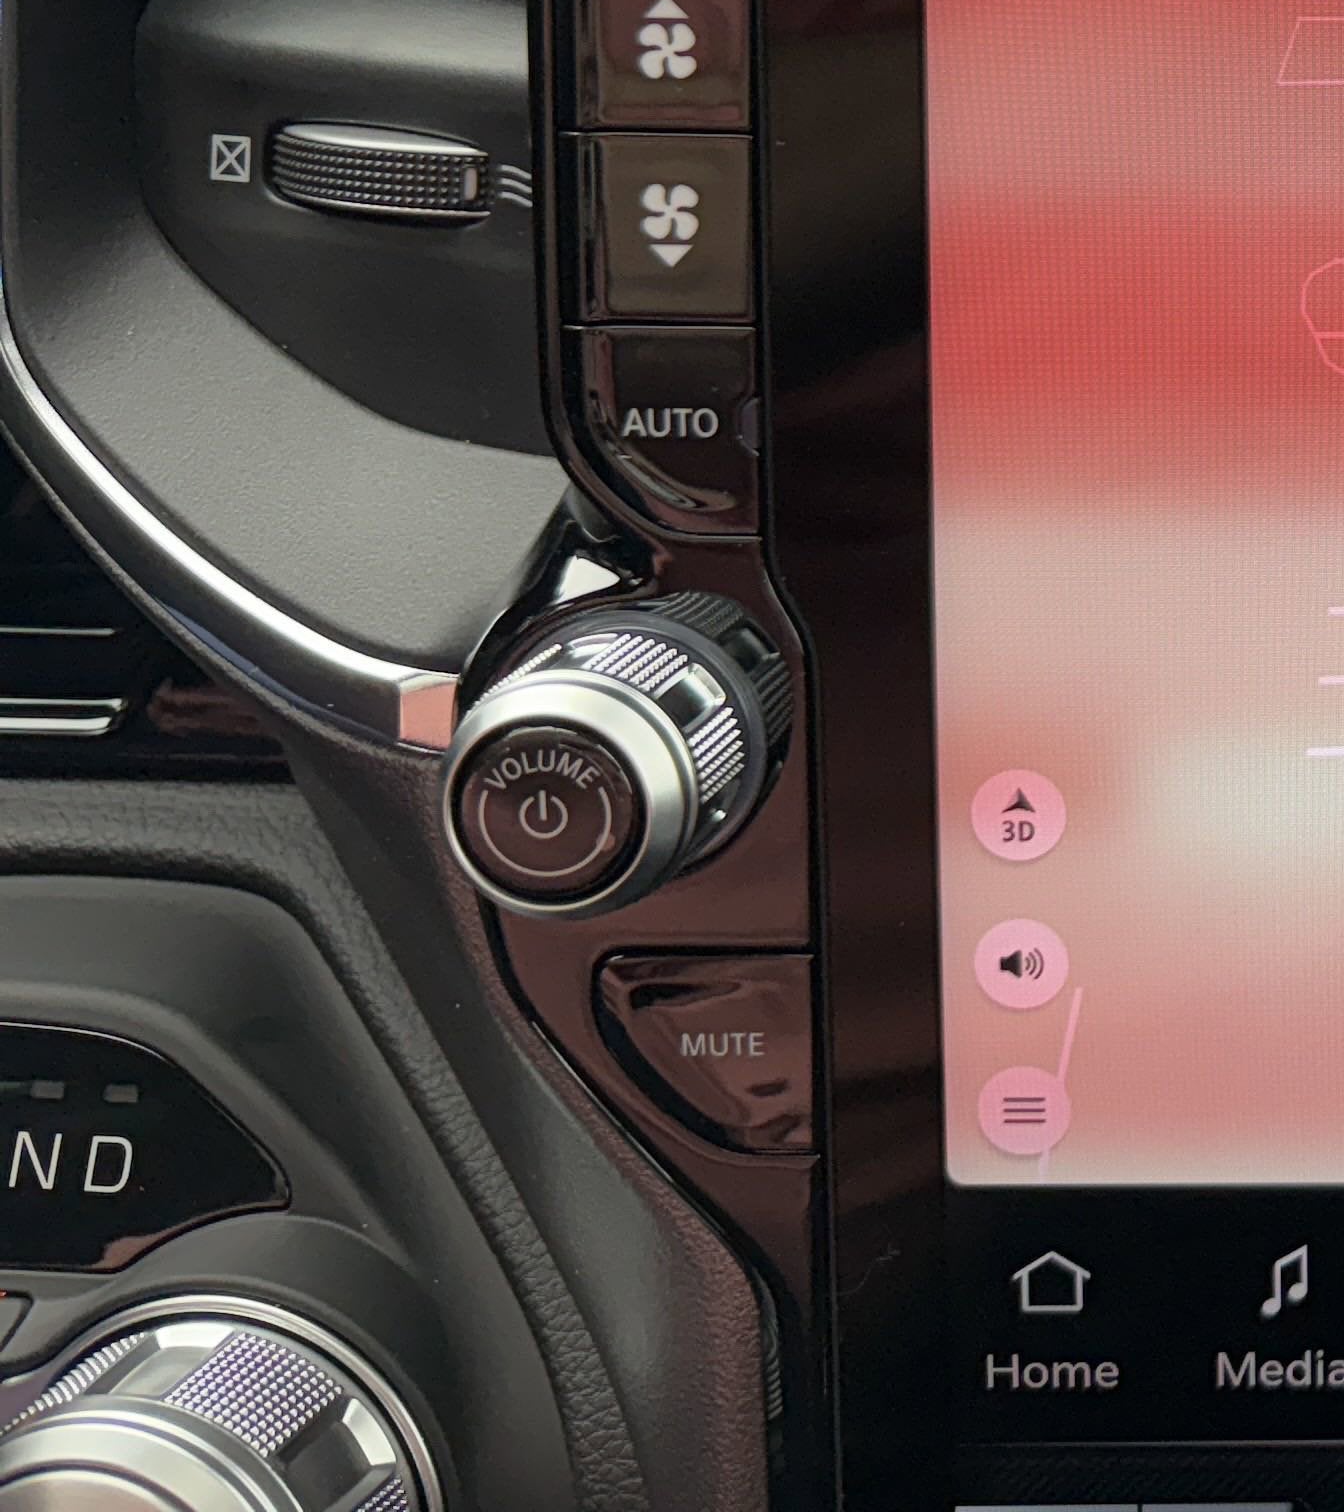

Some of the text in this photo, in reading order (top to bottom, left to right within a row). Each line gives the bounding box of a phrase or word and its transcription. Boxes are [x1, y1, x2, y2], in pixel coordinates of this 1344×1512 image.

[622, 408, 719, 438] AUTO
[484, 748, 602, 792] VOLUME
[1002, 820, 1036, 842] 3D
[680, 1032, 766, 1057] MUTE
[8, 1130, 134, 1193] N D
[986, 1354, 1120, 1391] Home
